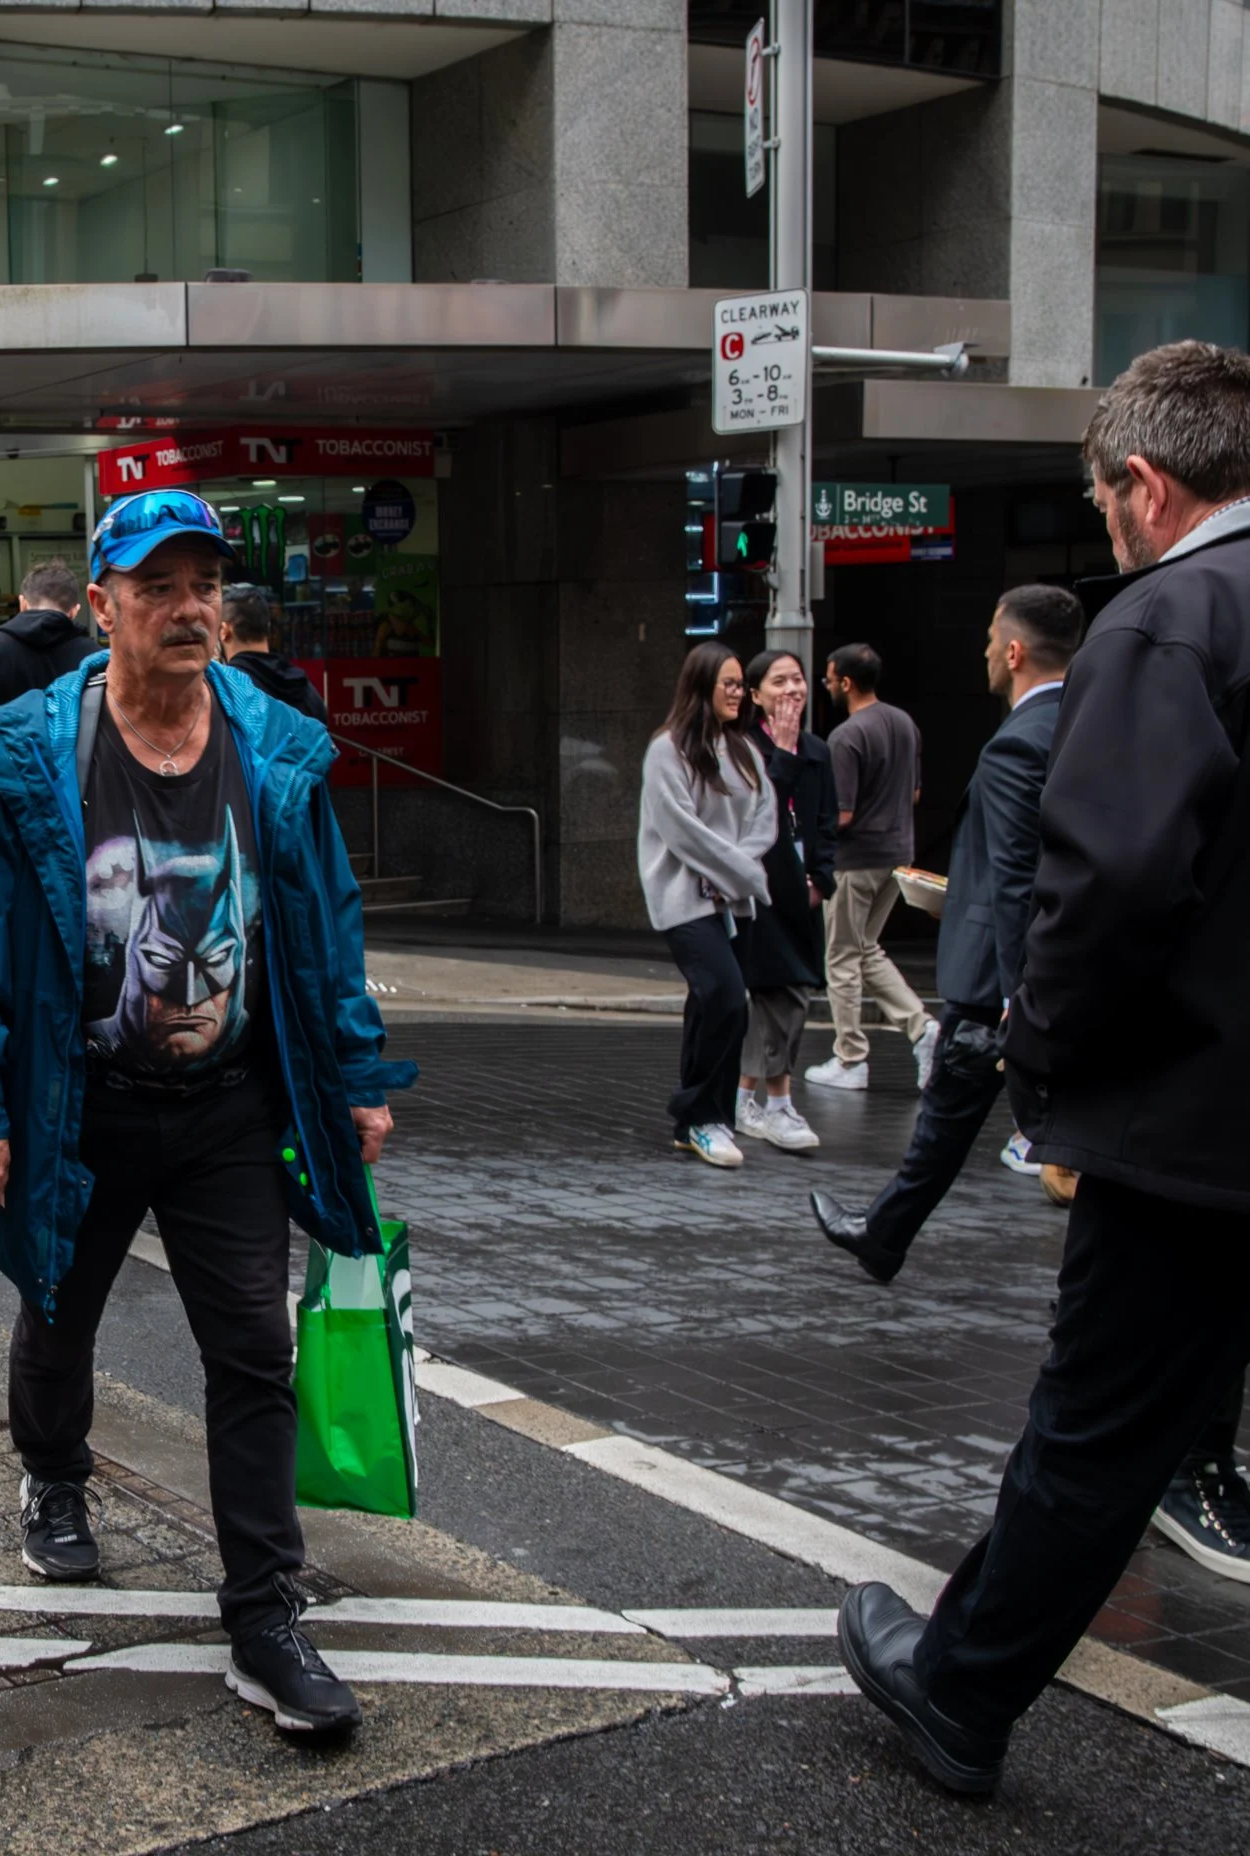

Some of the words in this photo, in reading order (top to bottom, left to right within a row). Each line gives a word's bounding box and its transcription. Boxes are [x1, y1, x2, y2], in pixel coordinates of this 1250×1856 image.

[720, 300, 800, 324] CLEARWAY
[730, 409, 755, 420] MON
[770, 405, 789, 416] FRI
[155, 439, 224, 467] TOBACCONIST
[315, 438, 432, 457] TOBACCONIST
[844, 489, 904, 518] Bridge
[908, 491, 928, 513] St
[333, 710, 429, 727] TOBACCONIST
